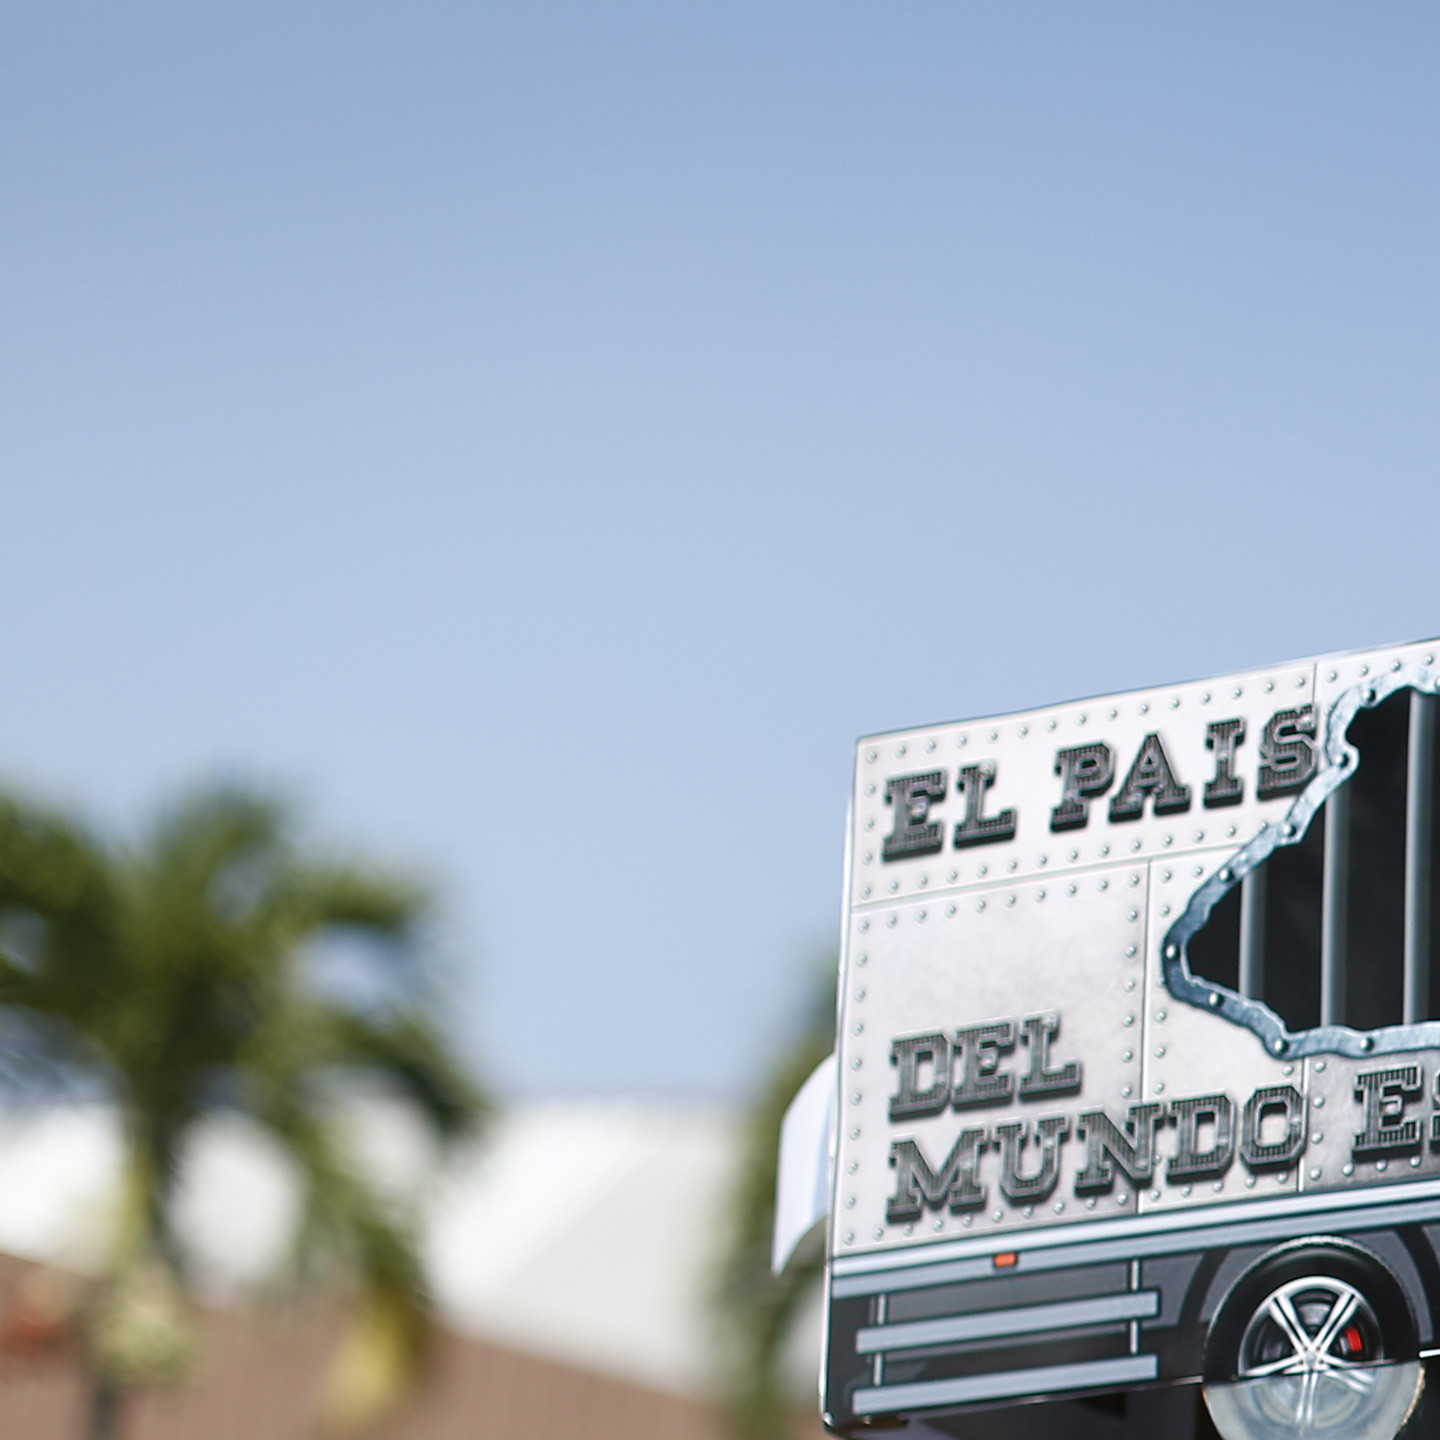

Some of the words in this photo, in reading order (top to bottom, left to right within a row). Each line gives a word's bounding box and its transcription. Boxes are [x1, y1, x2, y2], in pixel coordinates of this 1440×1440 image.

[881, 762, 1017, 863] EL
[1050, 702, 1320, 833] PAIS
[888, 1012, 1081, 1124] DEL
[885, 1081, 1307, 1225] MUNDO
